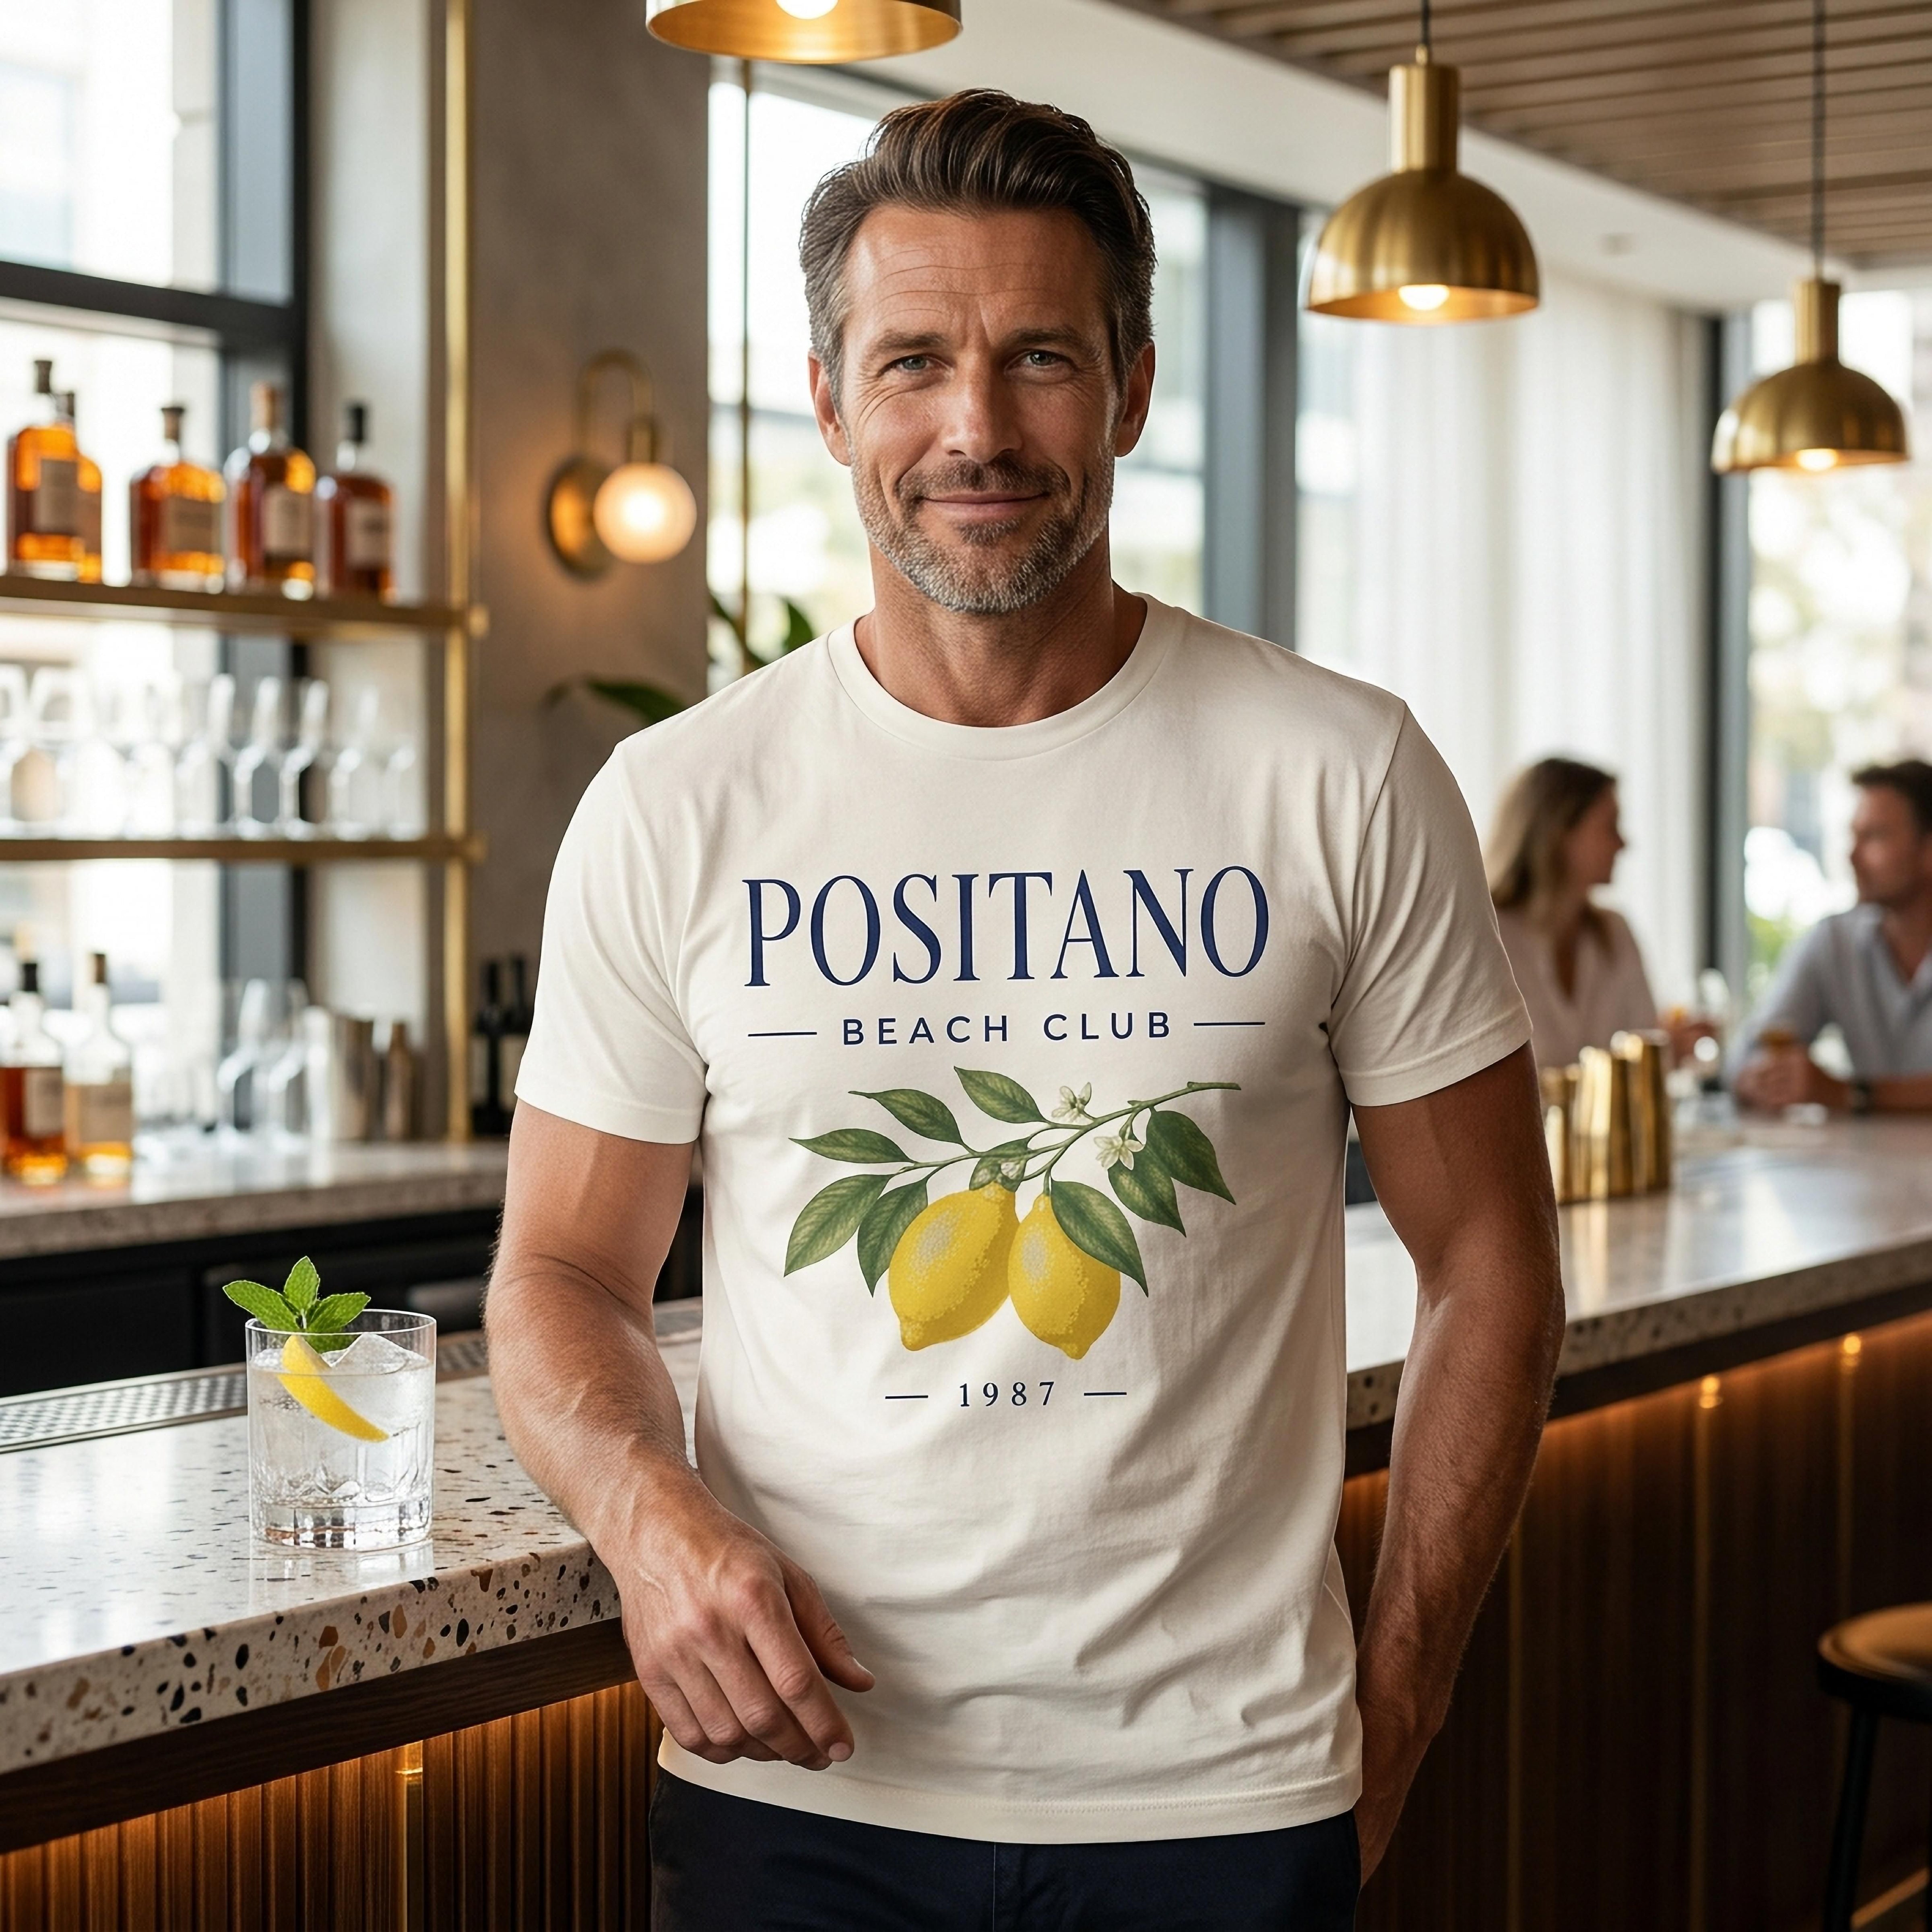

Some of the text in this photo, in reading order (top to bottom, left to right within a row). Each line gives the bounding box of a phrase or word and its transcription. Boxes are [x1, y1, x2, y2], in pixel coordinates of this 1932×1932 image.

[741, 865, 1269, 987] POSITANO
[843, 1011, 1170, 1046] BEACH CLUB
[959, 1381, 1055, 1408] 1987
